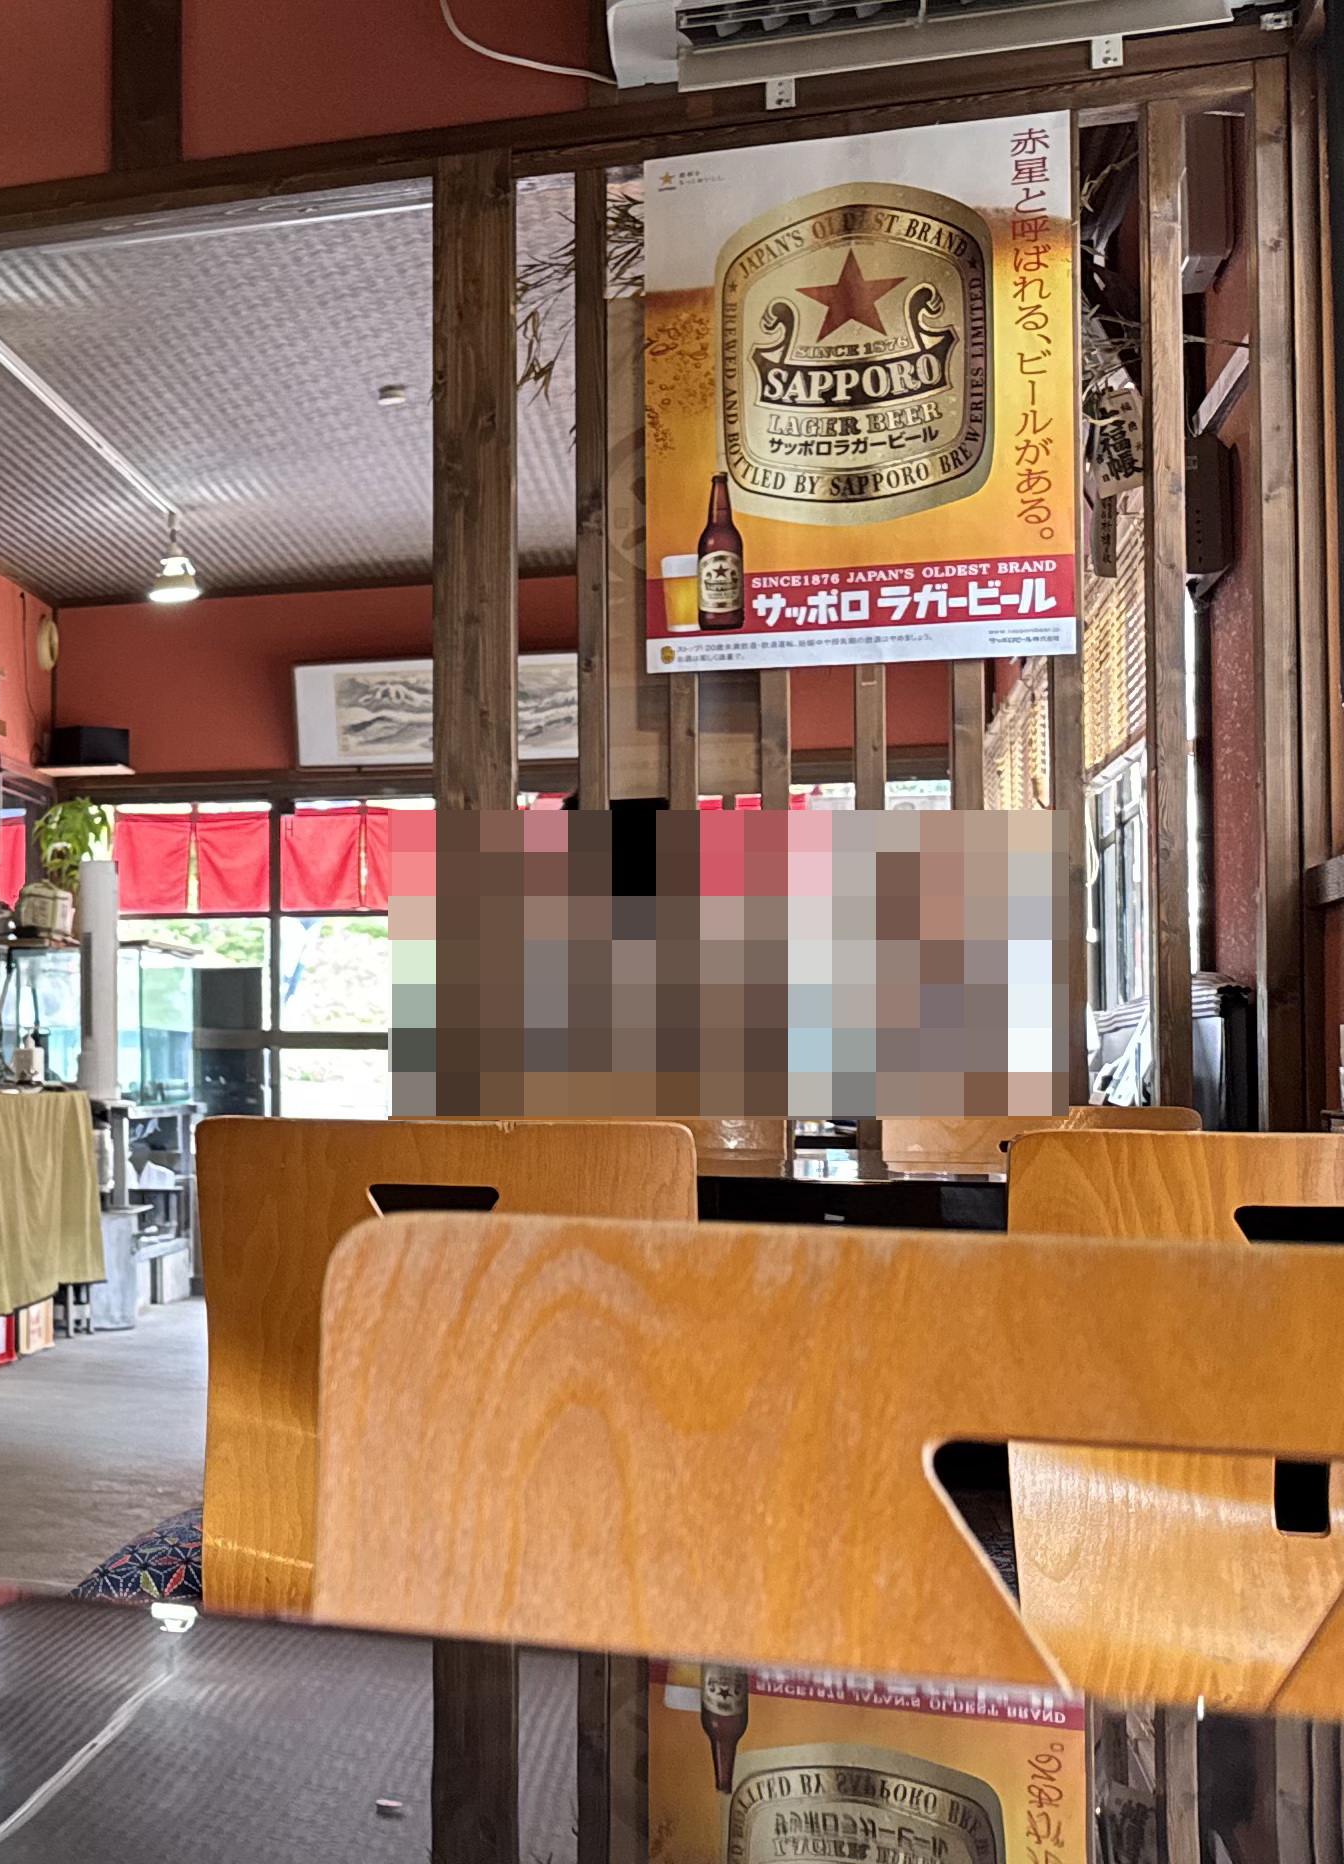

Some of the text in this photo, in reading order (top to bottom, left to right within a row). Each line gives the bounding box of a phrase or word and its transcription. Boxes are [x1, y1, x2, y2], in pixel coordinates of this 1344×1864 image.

[738, 229, 805, 281] JAPAN'S
[903, 217, 969, 258] BRAND
[794, 335, 910, 360] SINCE 1876
[1010, 127, 1055, 541] 赤星と呼ばれる、ビールがある。
[724, 276, 986, 498] BREWED AND BOTTLED BY SAPPORO BREWERIES LIMITED
[763, 353, 943, 405] SAPPORO
[768, 400, 944, 438] LAGER BEER
[768, 425, 940, 457] サッポロラガービール
[751, 572, 841, 590] SINCE1876
[846, 567, 916, 585] JAPAN'S
[922, 563, 992, 579] OLDEST
[997, 559, 1058, 575] BRAND
[751, 588, 871, 628] サッポロ
[877, 577, 1058, 622] ラガービール
